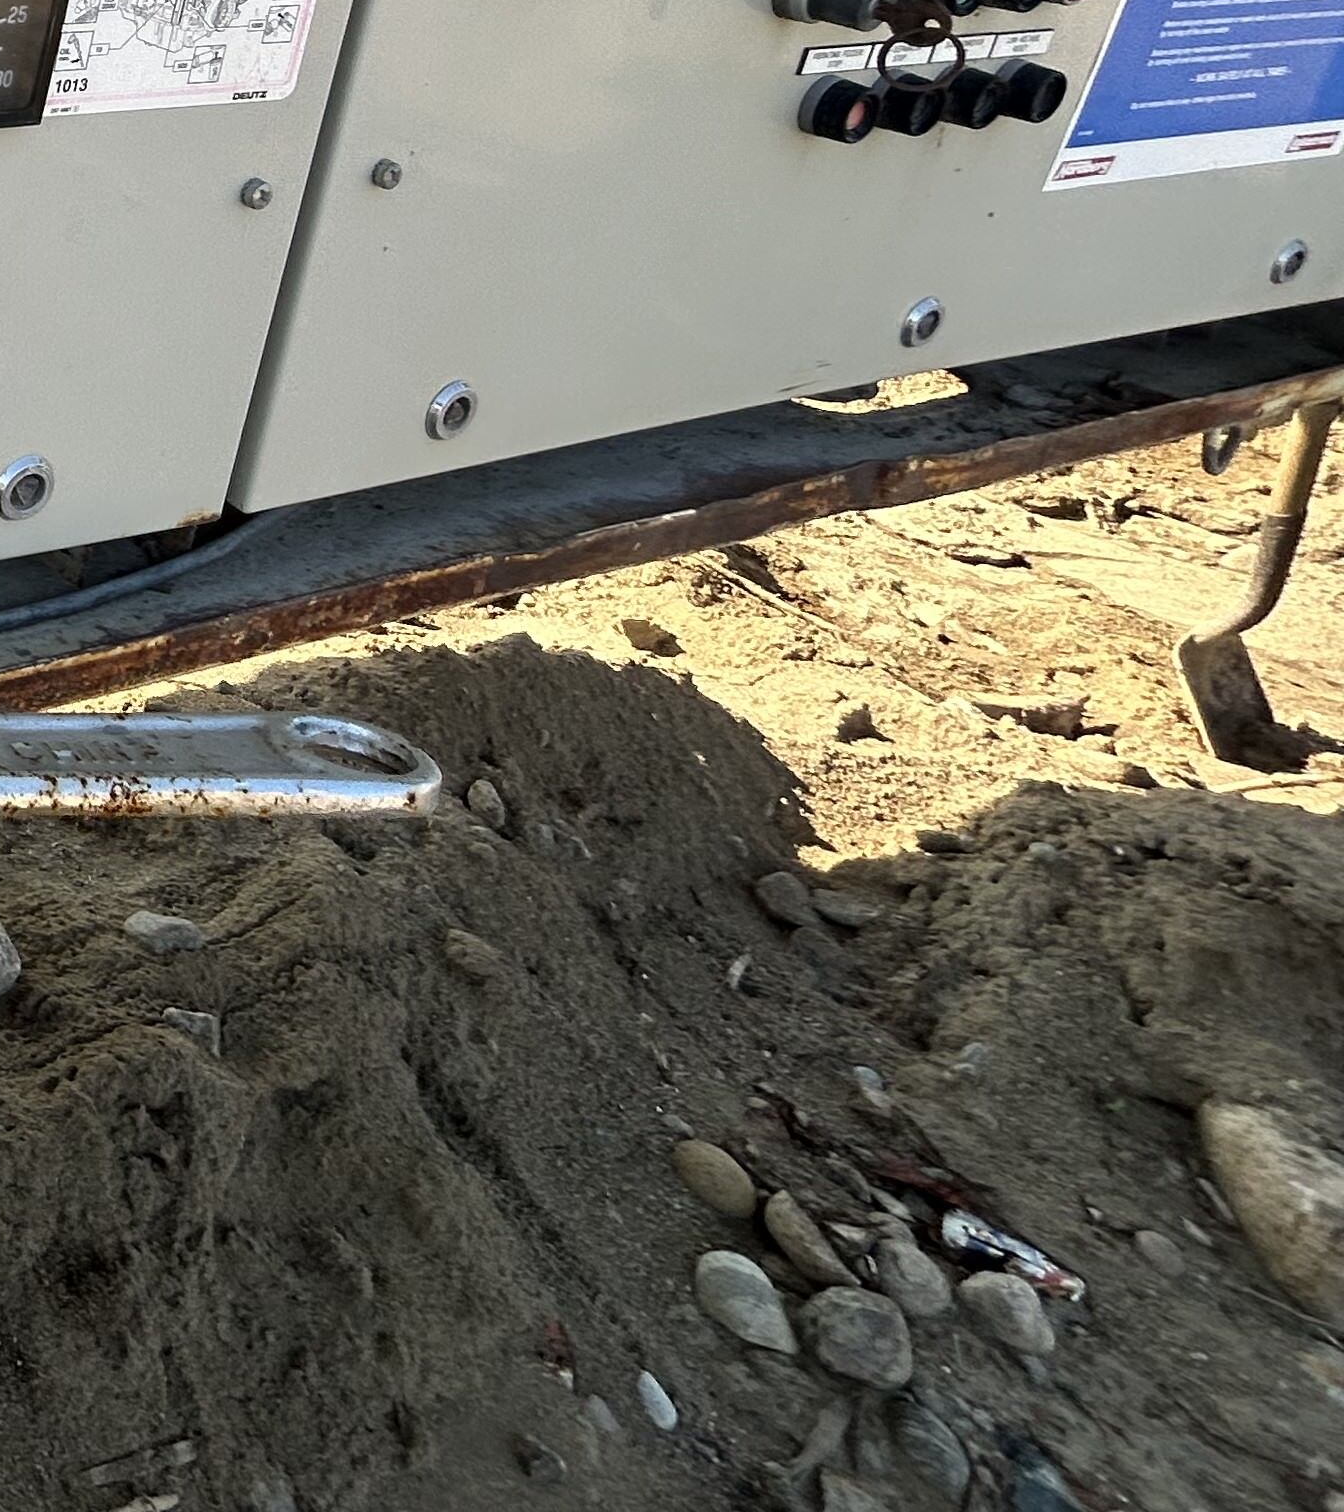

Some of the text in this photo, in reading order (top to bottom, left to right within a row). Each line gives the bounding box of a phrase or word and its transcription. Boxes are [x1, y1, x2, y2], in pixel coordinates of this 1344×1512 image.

[7, 5, 29, 25] 25
[55, 77, 89, 93] 1013
[232, 90, 268, 100] DEUTZ
